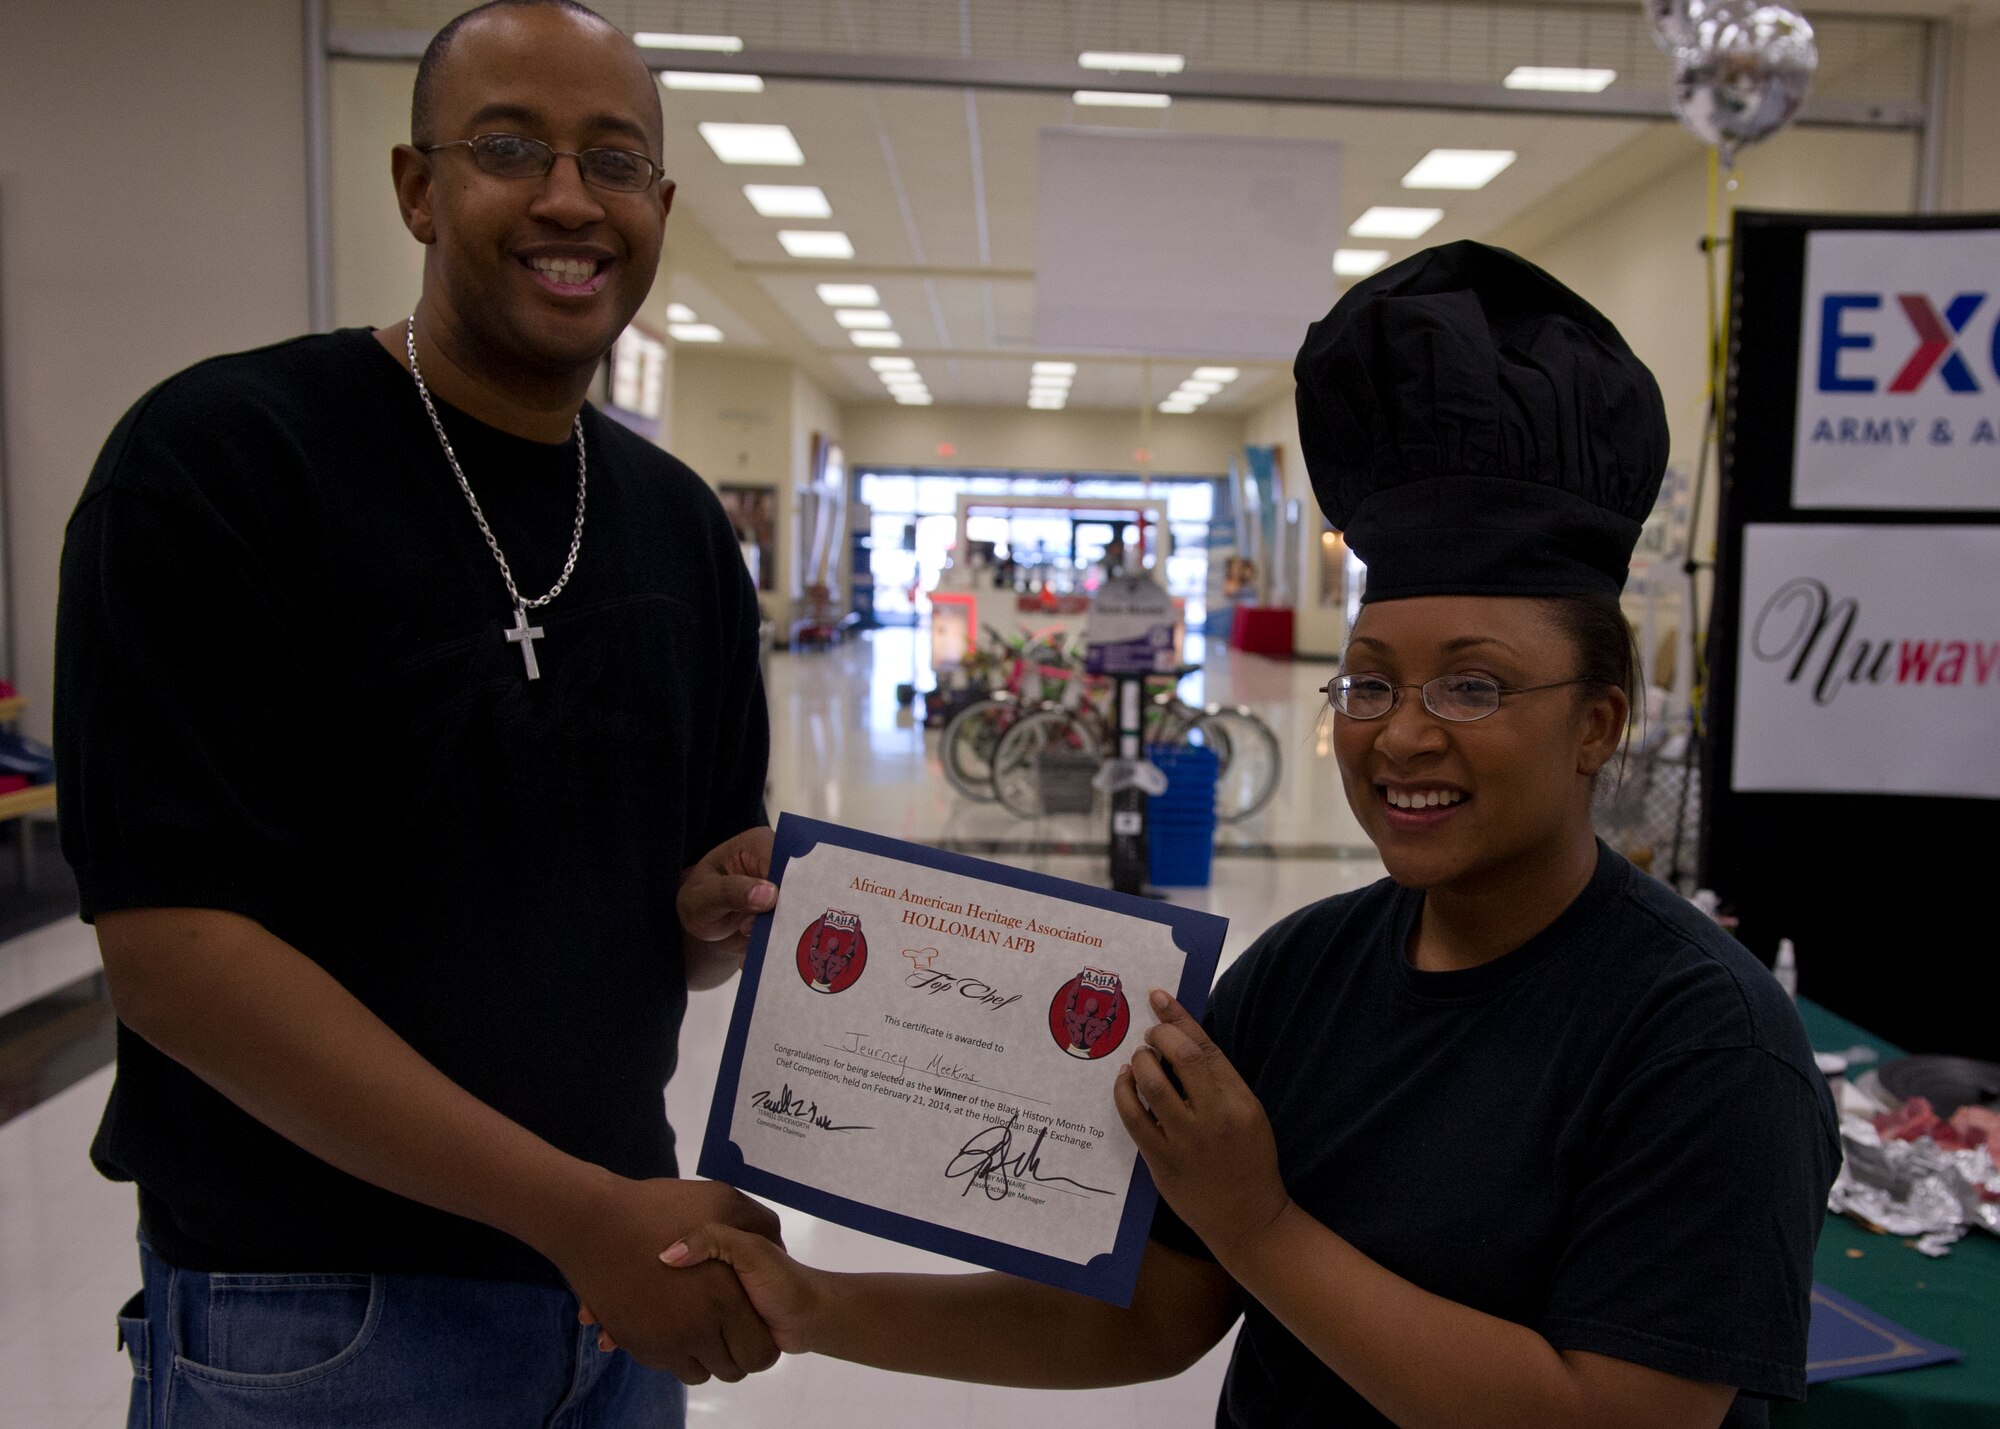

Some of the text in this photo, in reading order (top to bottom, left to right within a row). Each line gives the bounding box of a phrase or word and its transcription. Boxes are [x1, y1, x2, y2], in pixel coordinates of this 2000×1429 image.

[1816, 292, 2000, 394] EX
[1812, 417, 2000, 446] ARMY & A
[1751, 577, 2000, 706] Nuwav
[826, 912, 857, 928] AAHA
[849, 876, 1103, 948] African American Heritage Association
[901, 909, 1035, 954] HOLLOMAN AFB
[905, 969, 1022, 1011] Top Chef
[1083, 971, 1117, 988] AAHA
[884, 1014, 1004, 1053] This certificate is awarded to
[774, 1043, 1105, 1139] Congratulations for being selected as the Winner of the Black History Month Top
[776, 1057, 793, 1069] Chef
[793, 1063, 841, 1084] Competition,
[842, 1077, 860, 1088] held
[861, 1082, 873, 1091] on
[873, 1085, 912, 1104] February
[912, 1094, 926, 1107] 21,
[928, 1099, 952, 1114] 2014,
[954, 1107, 964, 1116] at
[965, 1108, 981, 1120] the
[1050, 1131, 1094, 1150] Exchange.
[756, 1118, 807, 1139] Committee Chairman
[757, 1108, 777, 1121] TERRELL
[1017, 1192, 1046, 1206] Manager
